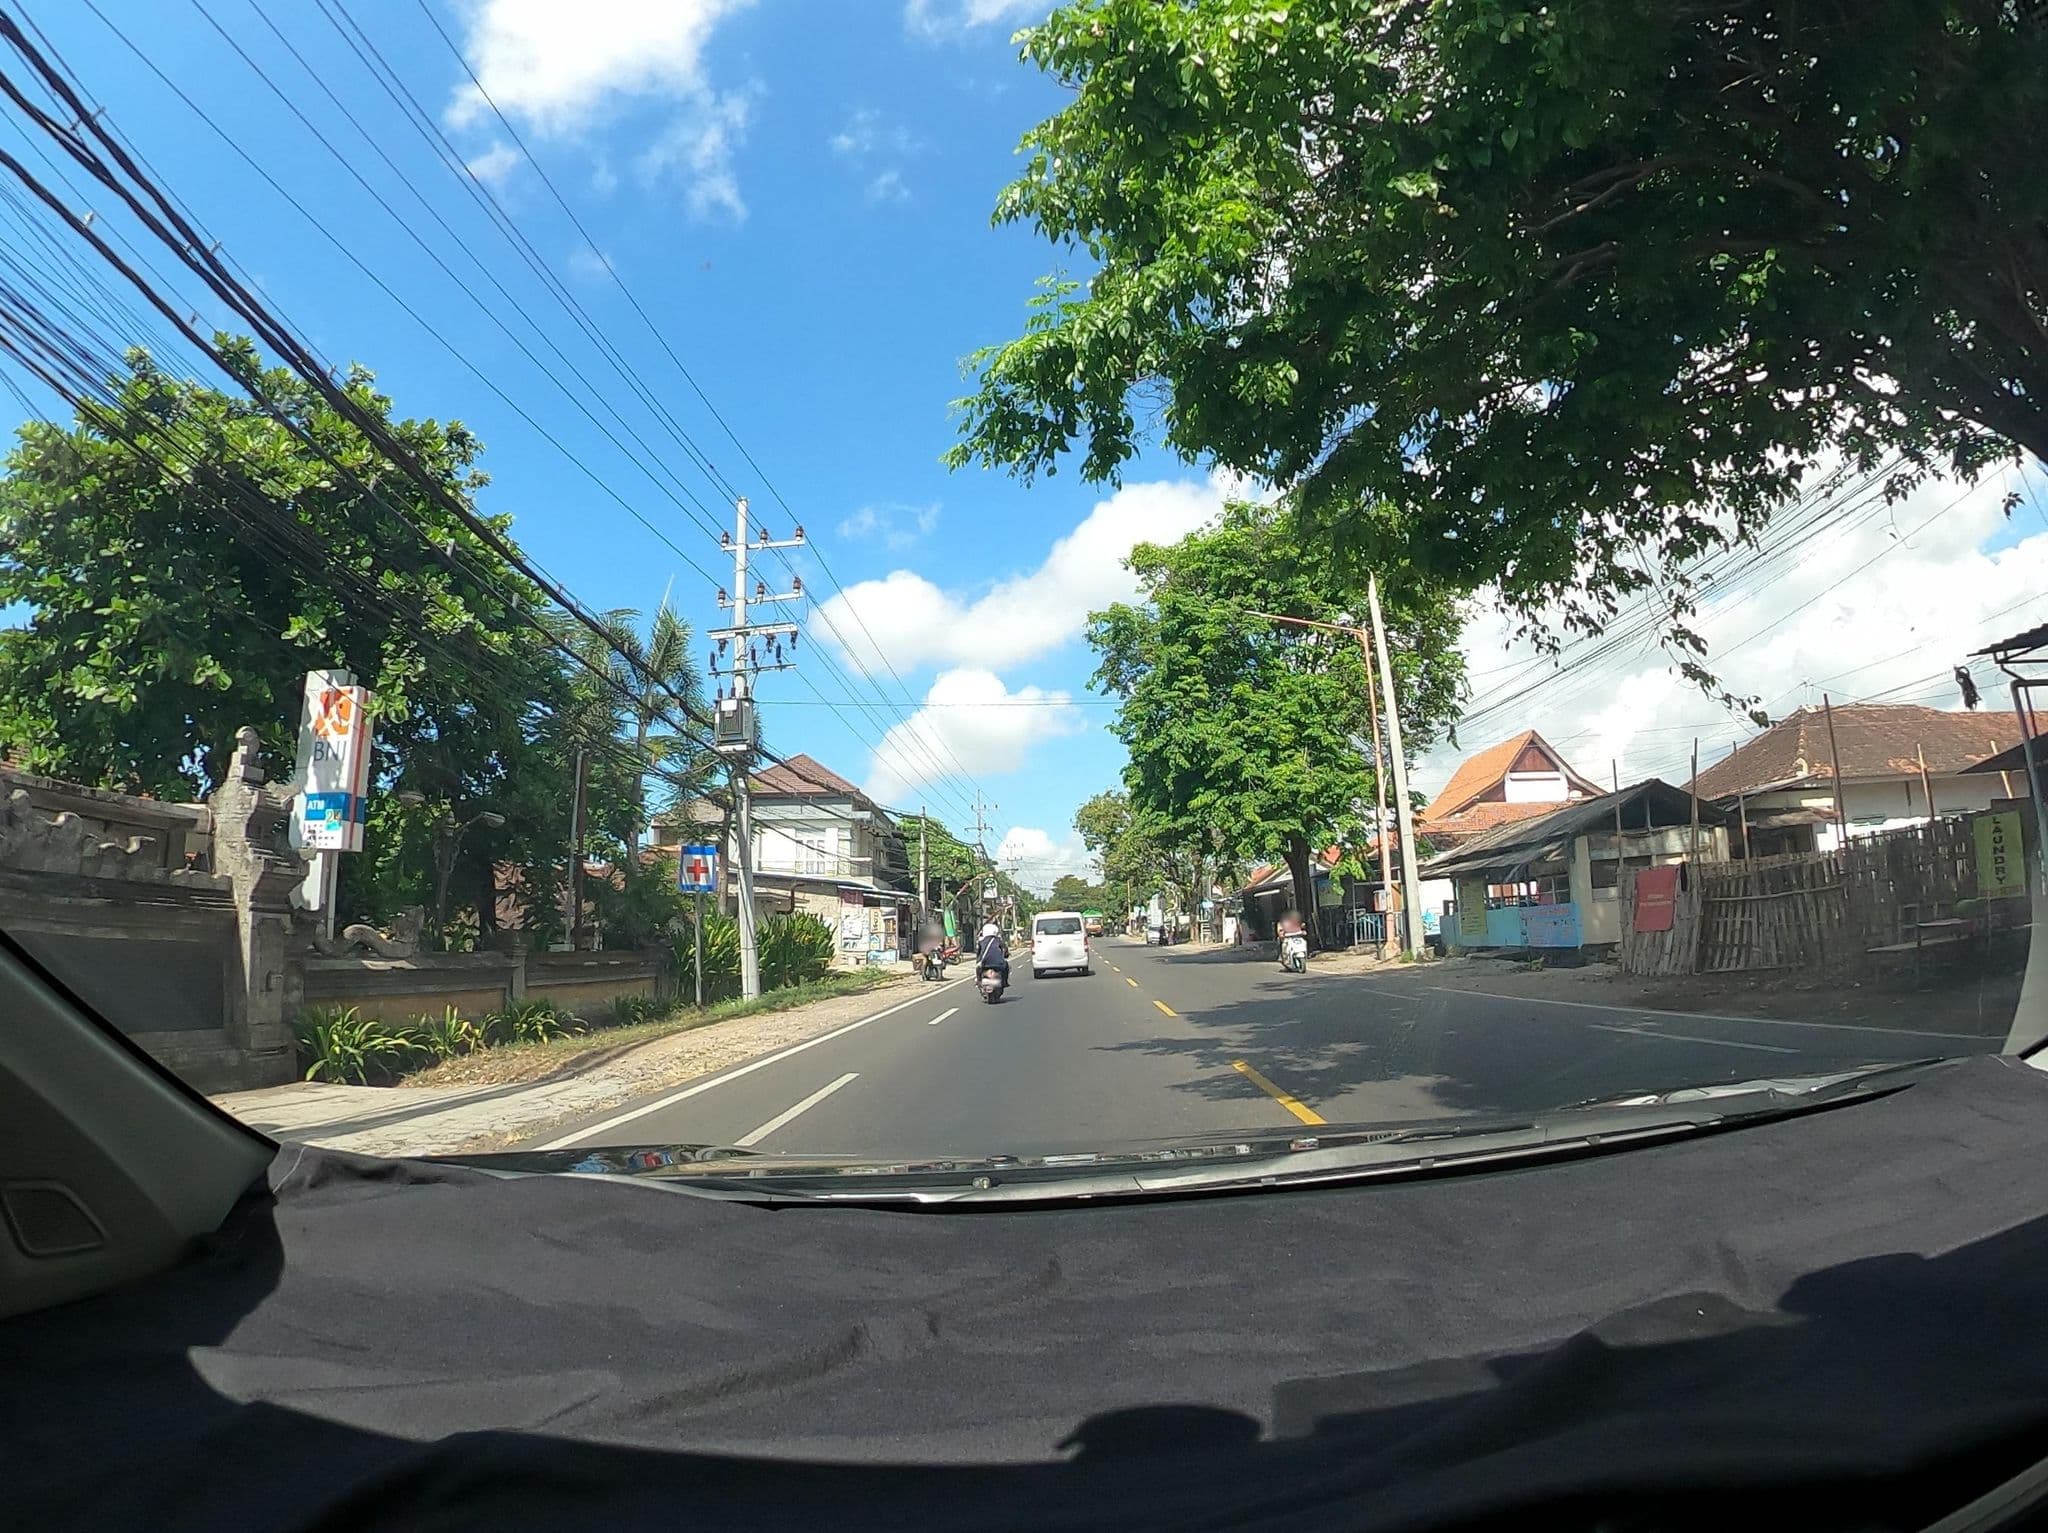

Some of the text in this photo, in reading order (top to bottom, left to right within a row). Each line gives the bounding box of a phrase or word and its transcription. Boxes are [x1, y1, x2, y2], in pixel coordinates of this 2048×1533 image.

[313, 742, 347, 761] BNI
[307, 799, 326, 811] ATM
[1992, 816, 2006, 885] LAUNDRY
